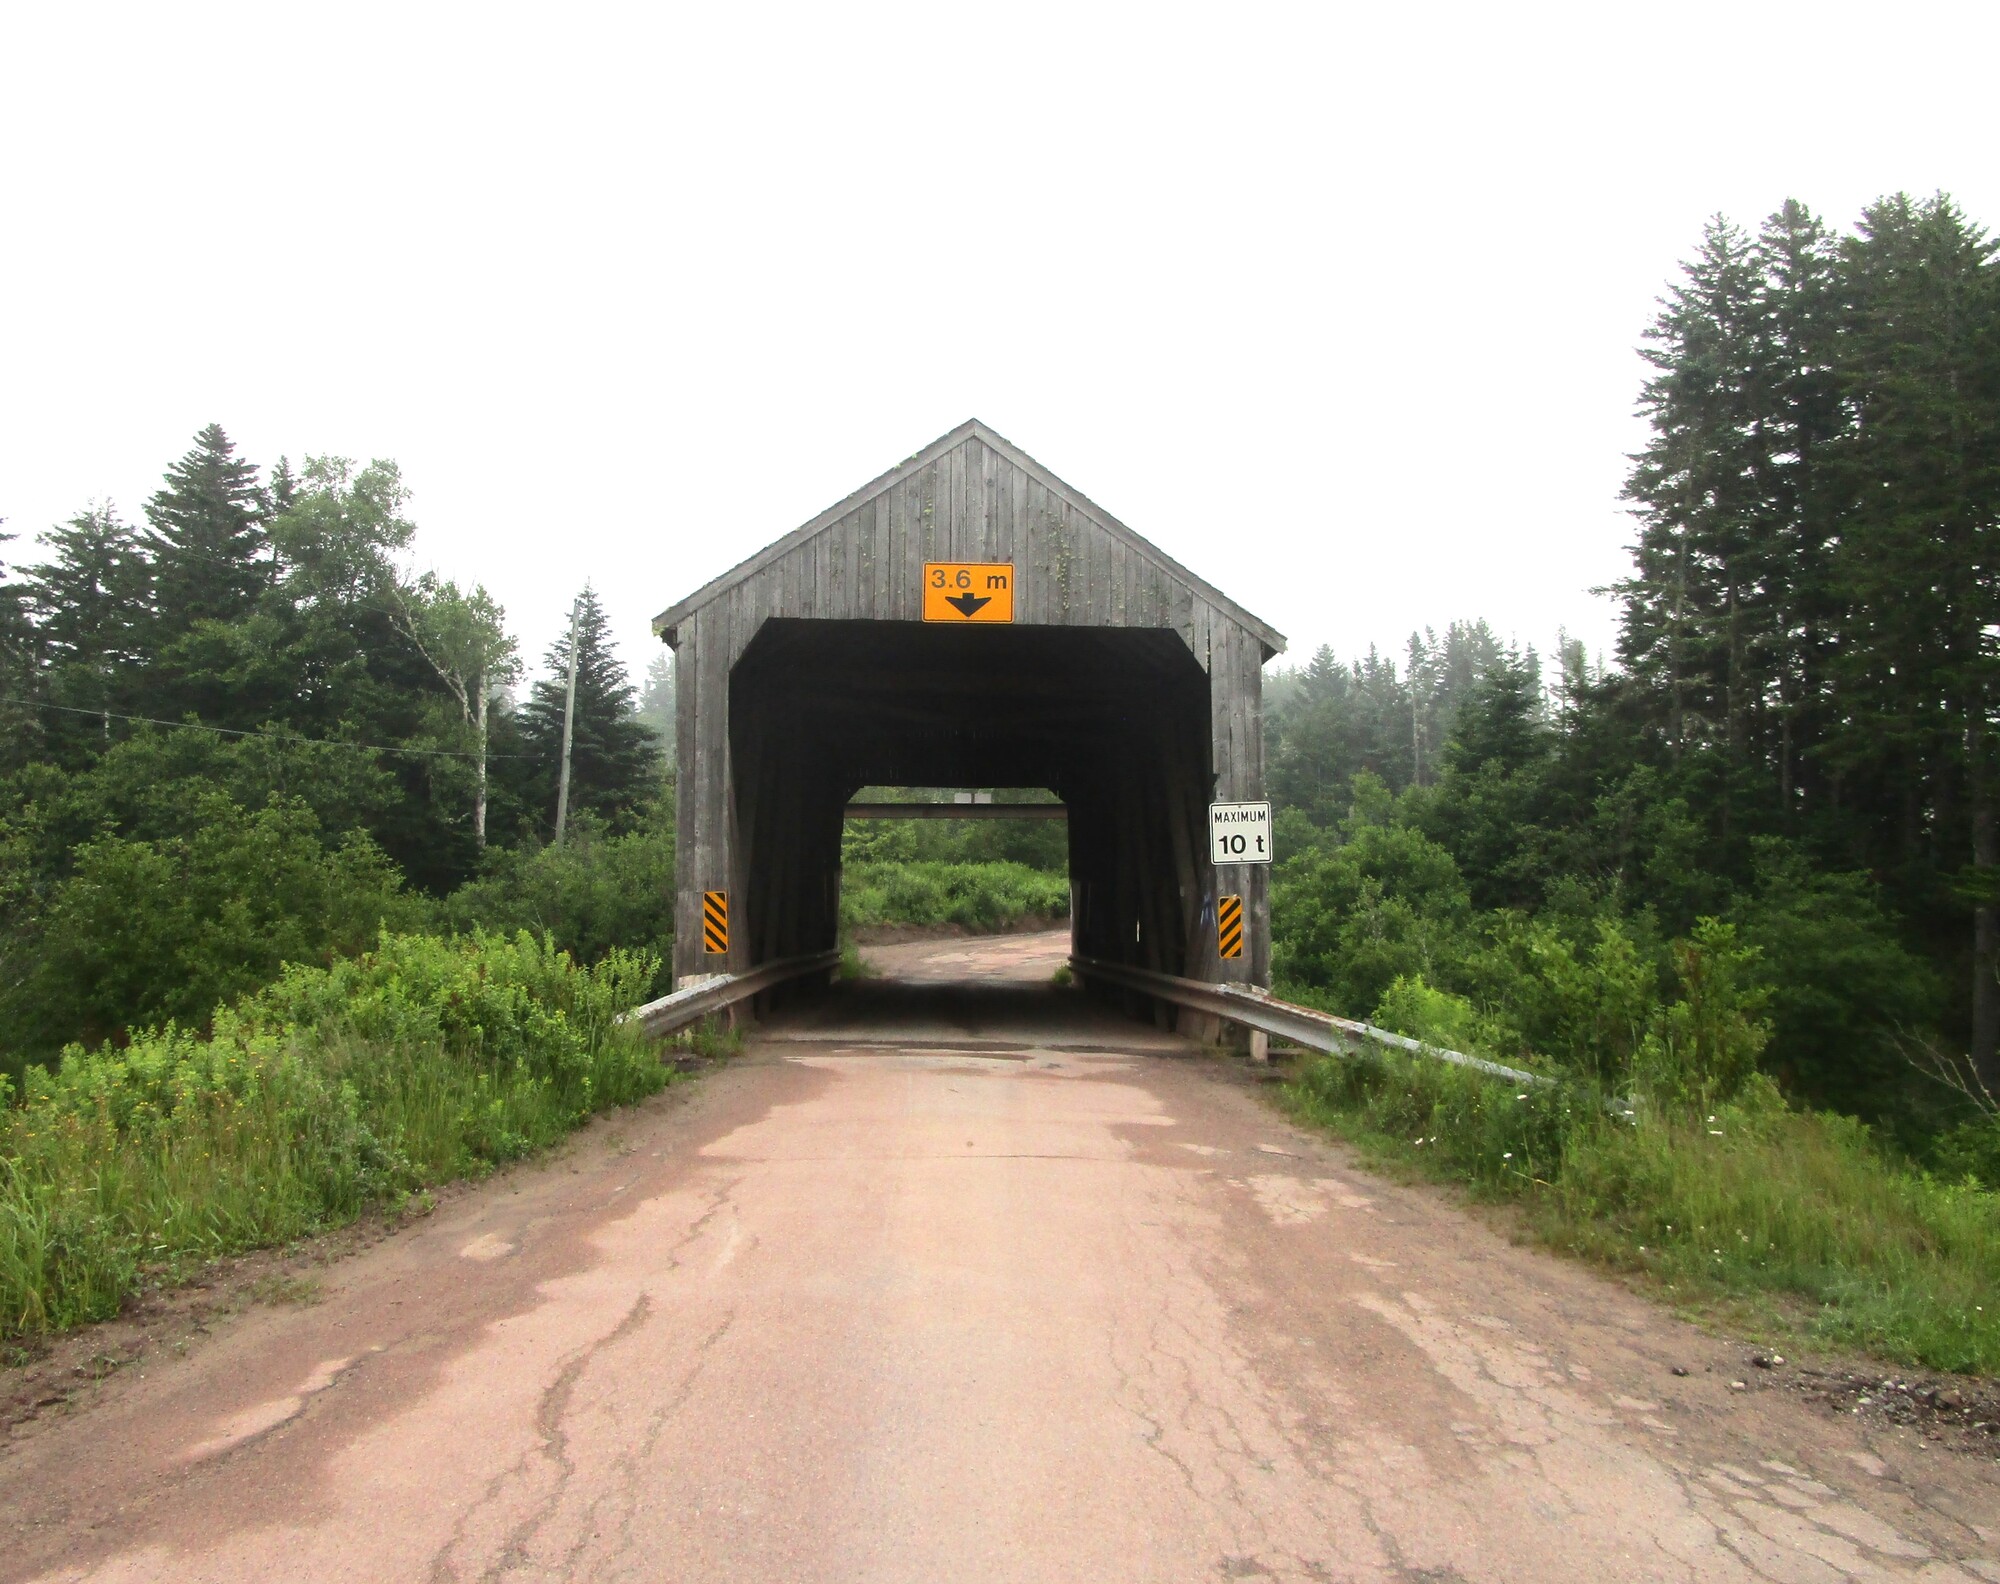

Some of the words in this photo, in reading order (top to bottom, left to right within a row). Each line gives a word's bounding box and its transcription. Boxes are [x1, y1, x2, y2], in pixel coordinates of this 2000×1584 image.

[931, 569, 971, 588] 3.6
[987, 575, 1006, 589] m
[1214, 810, 1266, 823] MAXIMUM
[1218, 834, 1246, 854] 10
[1255, 835, 1264, 853] t
